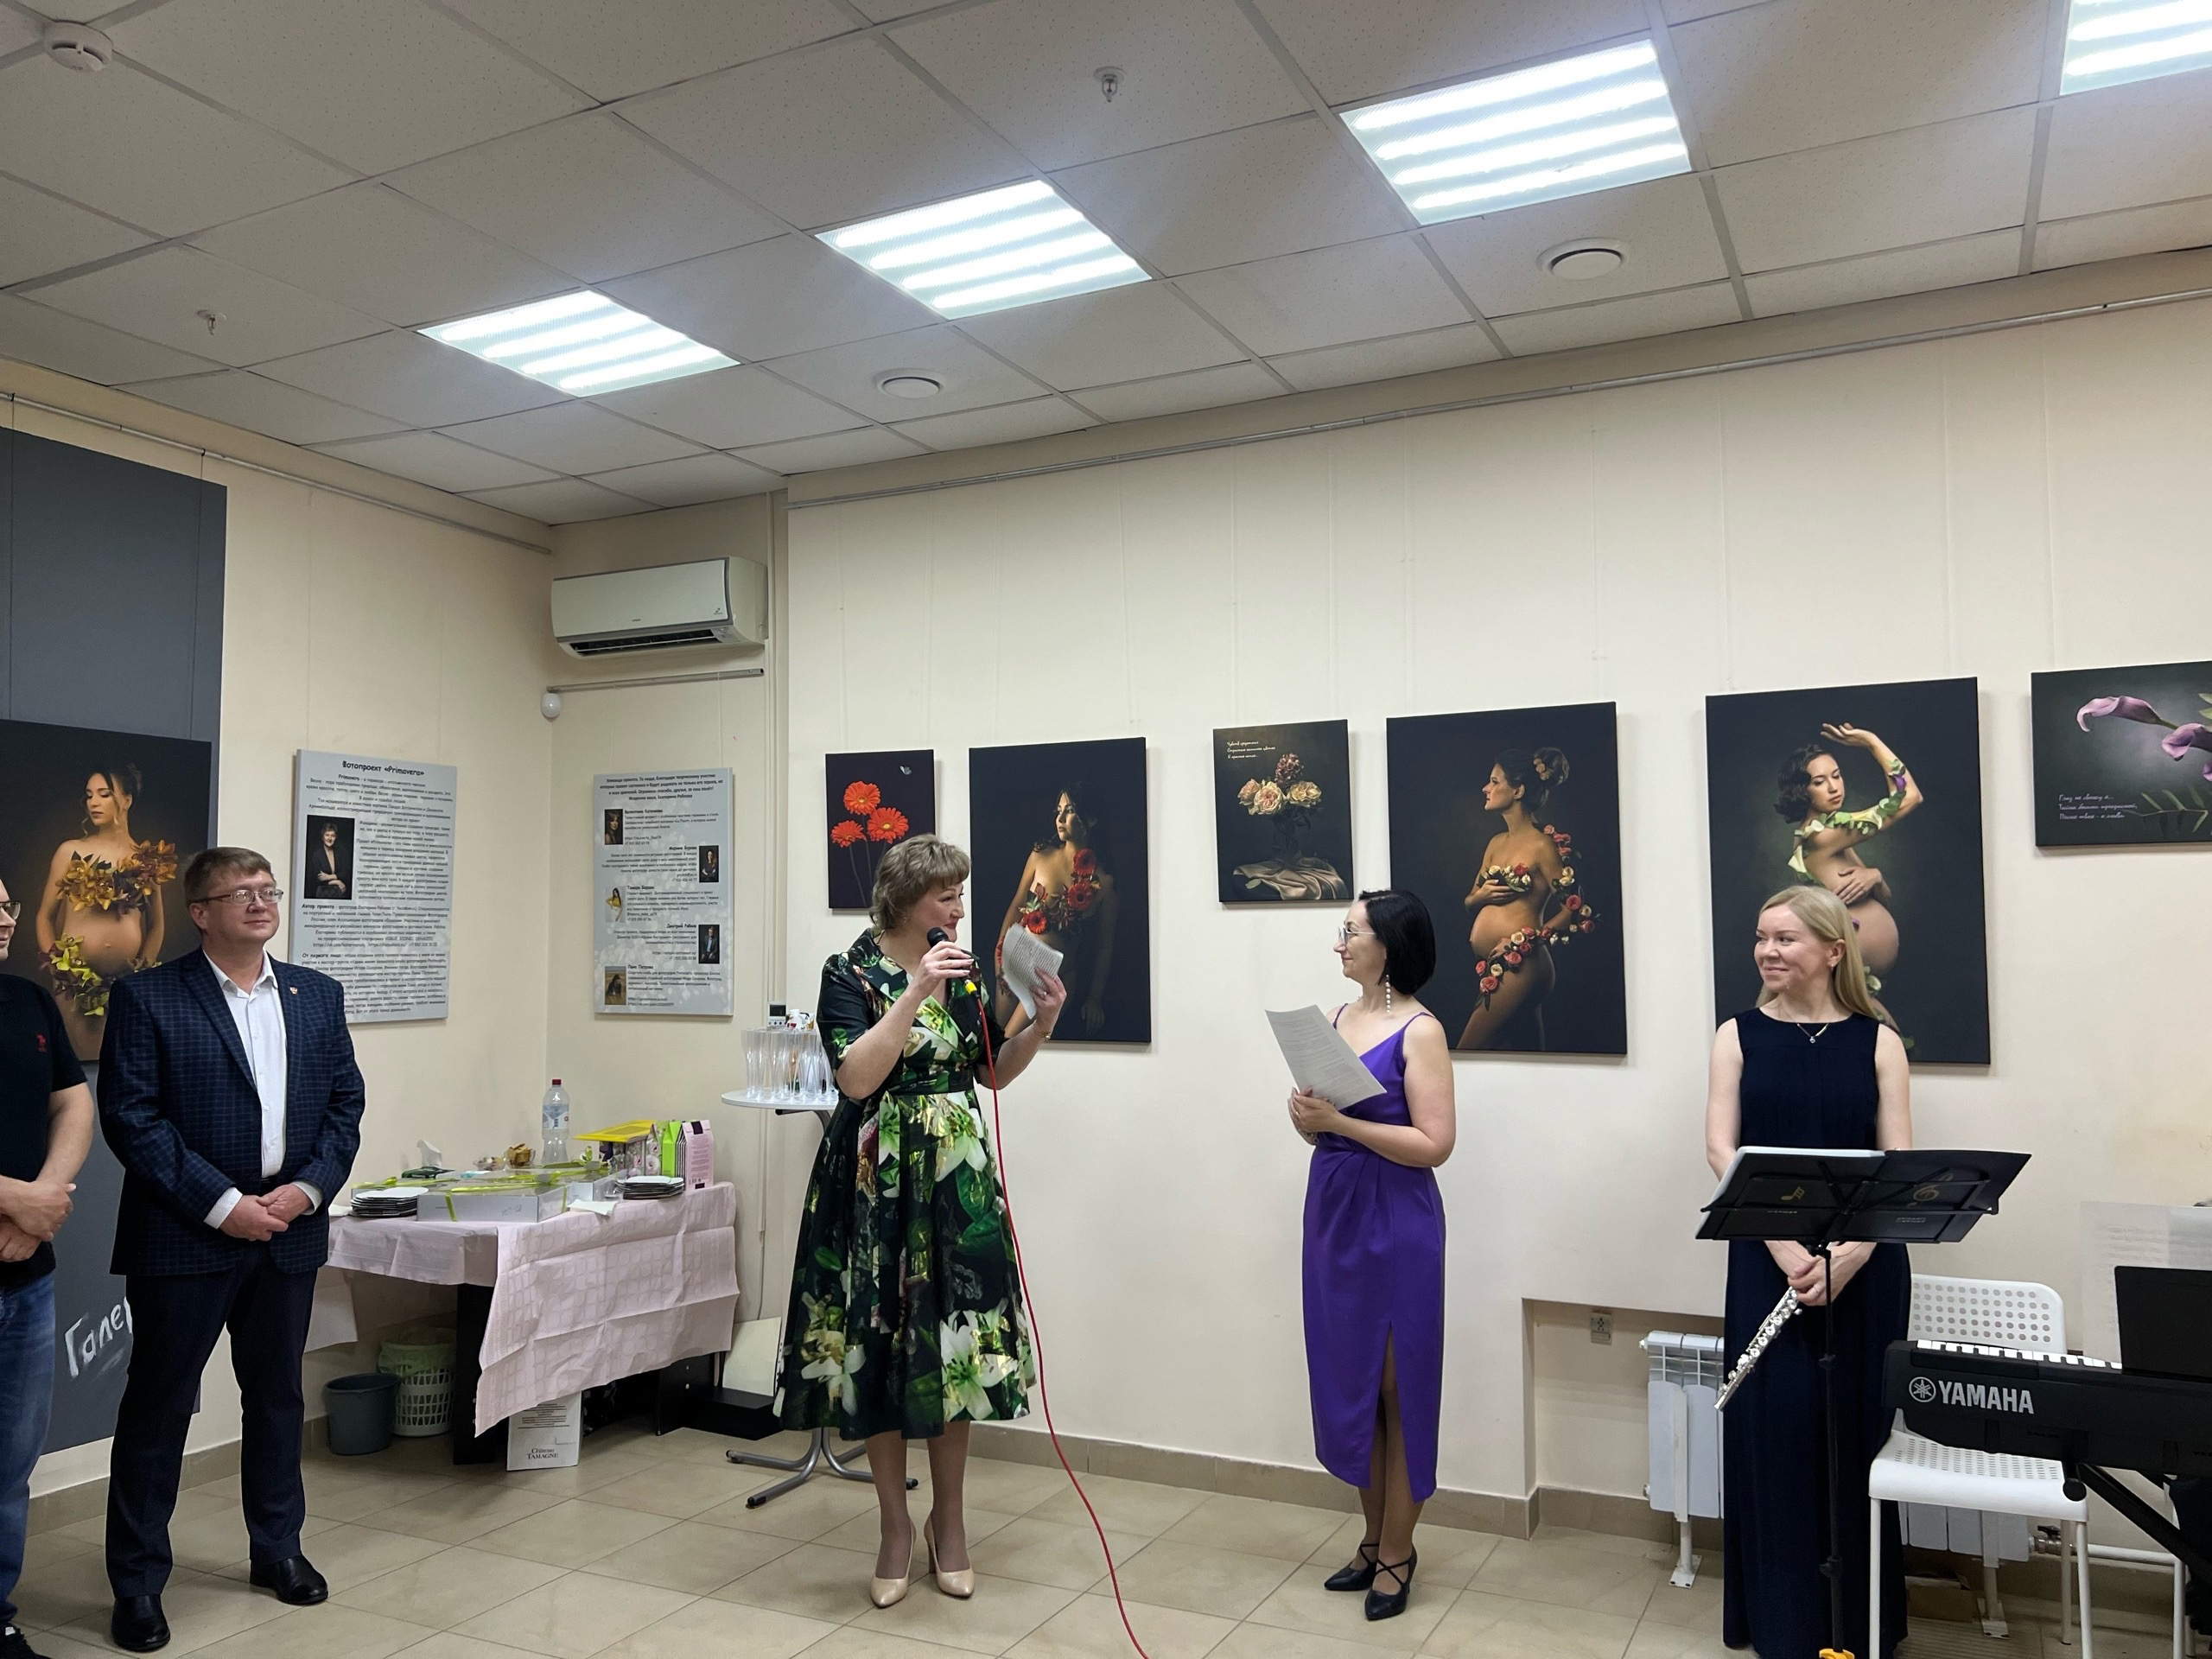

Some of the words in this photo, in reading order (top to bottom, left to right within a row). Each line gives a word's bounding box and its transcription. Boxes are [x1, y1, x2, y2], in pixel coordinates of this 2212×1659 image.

[342, 760, 381, 772] Фотопроект
[385, 766, 424, 776] «Primavera»
[1938, 1380, 2034, 1414] YAMAHA
